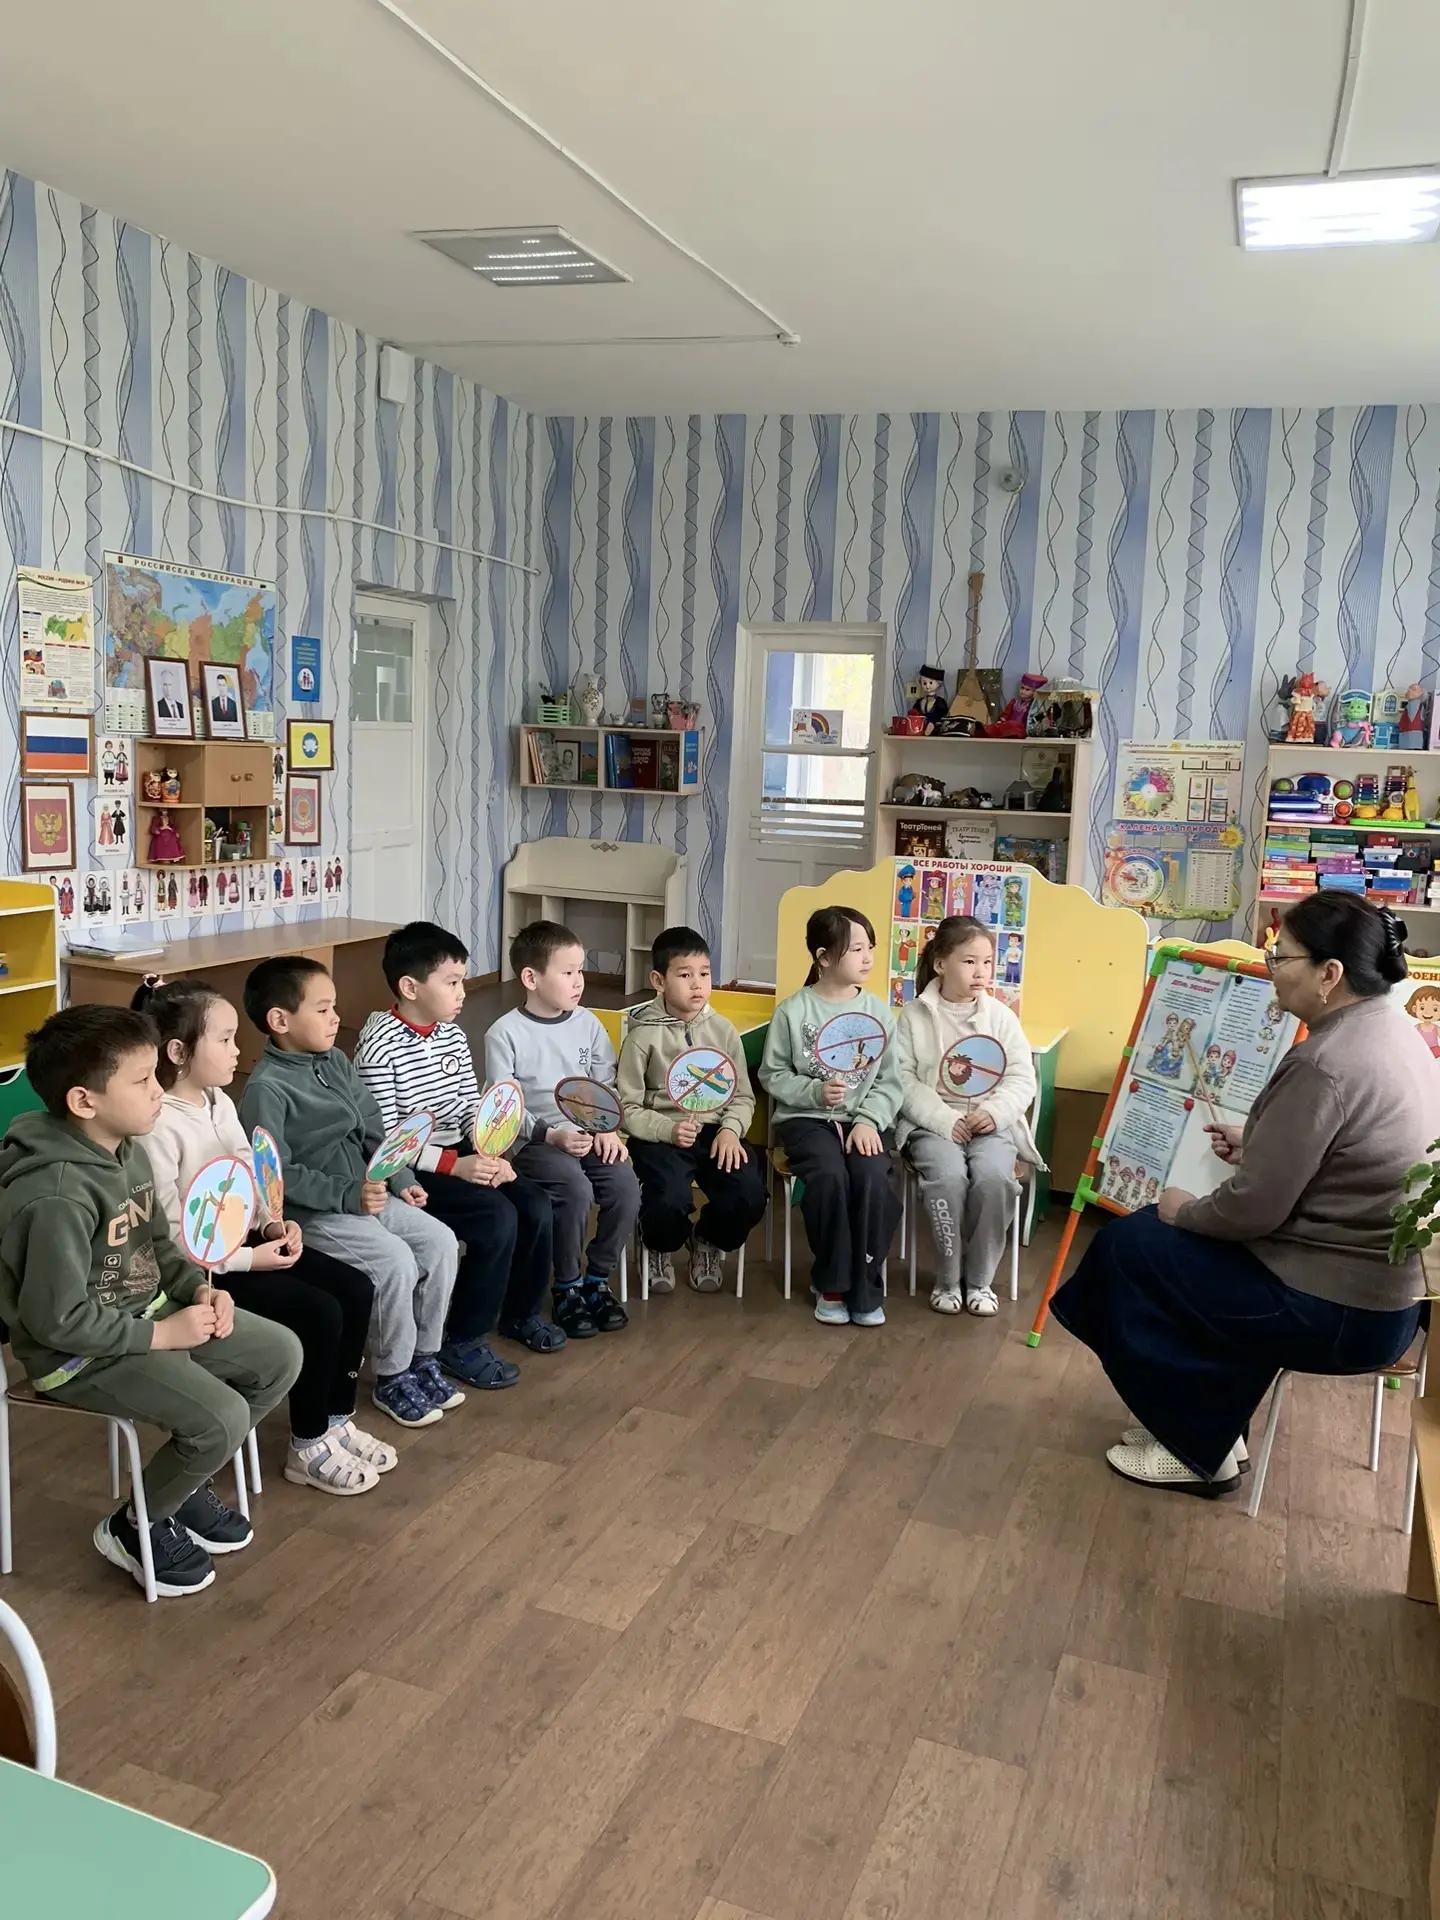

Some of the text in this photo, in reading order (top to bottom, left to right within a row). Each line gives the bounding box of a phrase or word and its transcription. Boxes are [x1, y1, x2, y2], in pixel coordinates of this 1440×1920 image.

[134, 559, 254, 587] РОССИЙСКАЯ ФЕДЕРАЦИЯ
[1120, 823, 1227, 834] КАЛЕНДАРЬ ПРИРОДЫ
[913, 859, 1013, 873] ВСЕ РАБОТЫ ХОРОШИ
[936, 1198, 956, 1257] adidas
